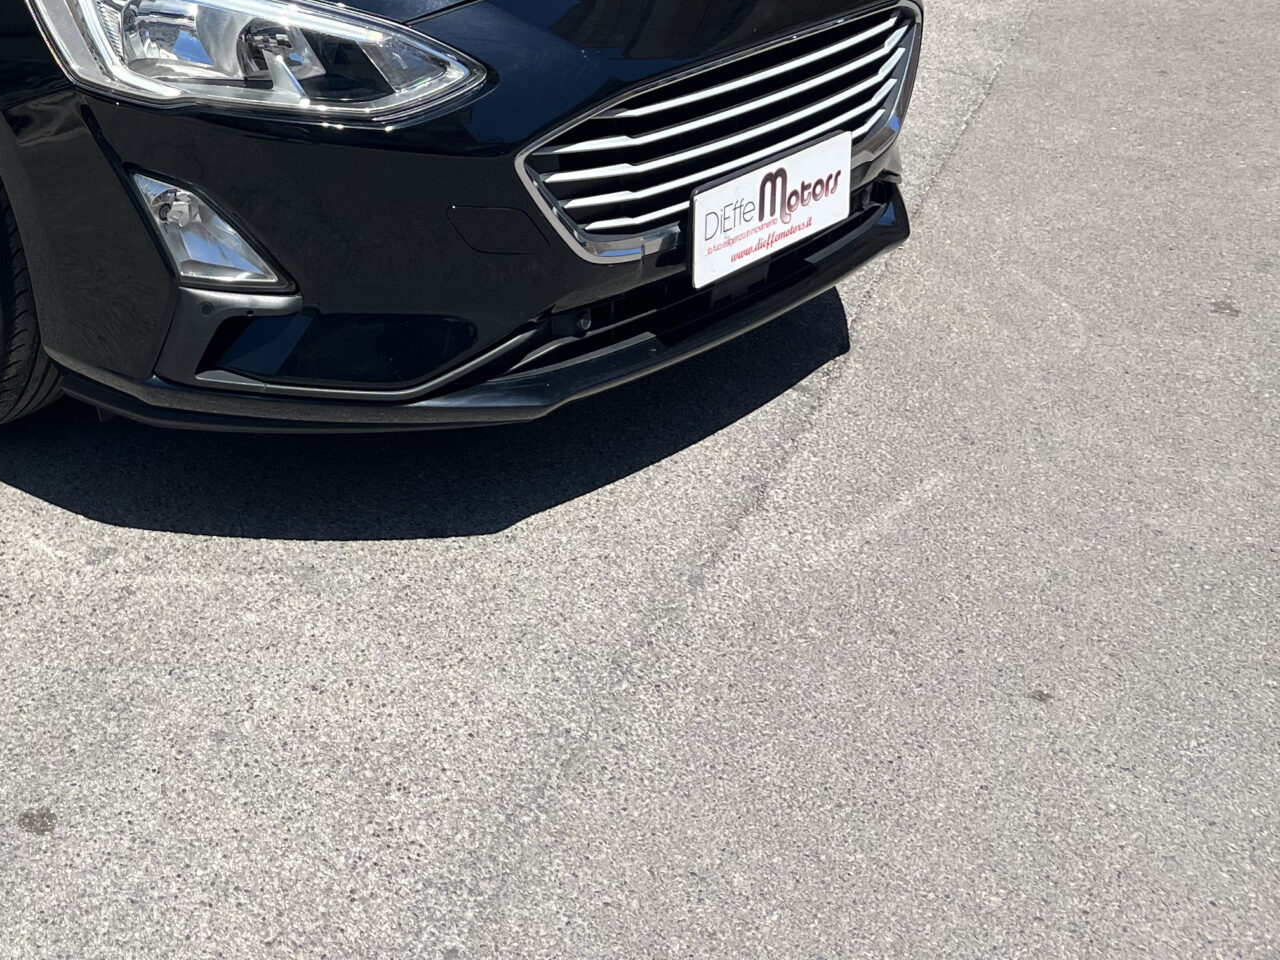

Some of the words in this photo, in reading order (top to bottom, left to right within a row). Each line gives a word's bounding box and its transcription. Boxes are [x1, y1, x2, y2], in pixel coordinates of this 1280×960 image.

[705, 198, 756, 242] DiEffe
[758, 167, 842, 224] Motors
[731, 216, 813, 262] www.dieffemotors.it
